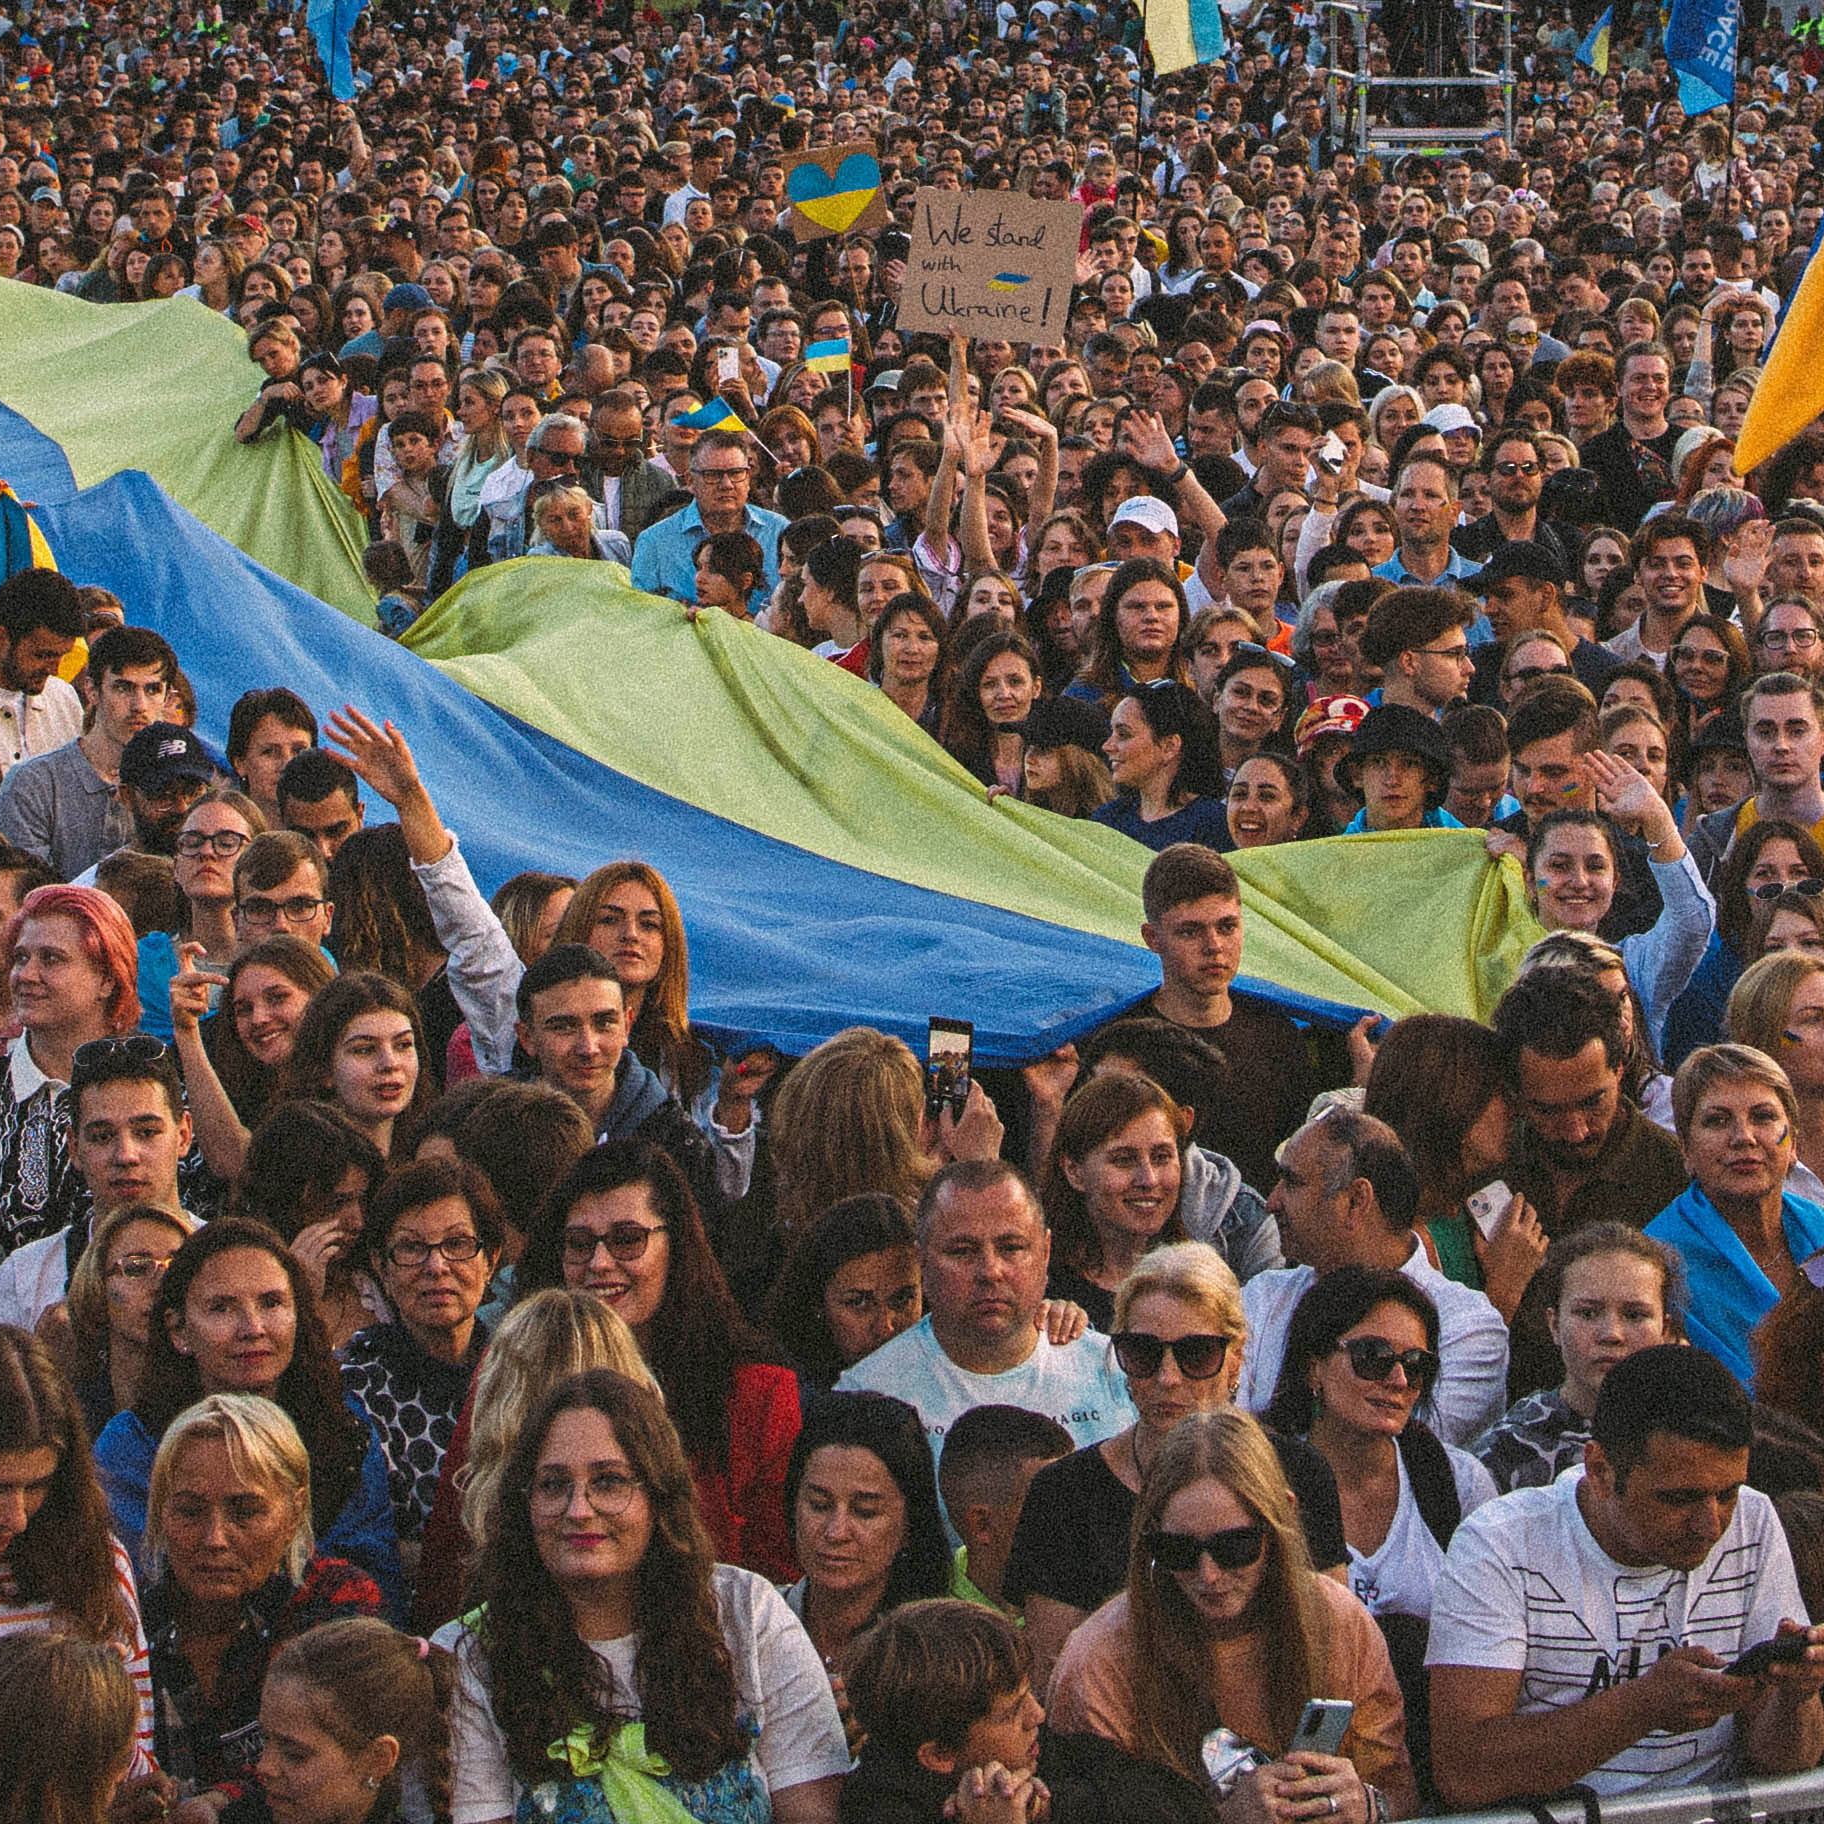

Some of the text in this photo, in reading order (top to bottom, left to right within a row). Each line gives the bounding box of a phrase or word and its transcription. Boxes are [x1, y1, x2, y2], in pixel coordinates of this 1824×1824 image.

[925, 203, 1046, 251] We stand
[921, 254, 962, 273] with
